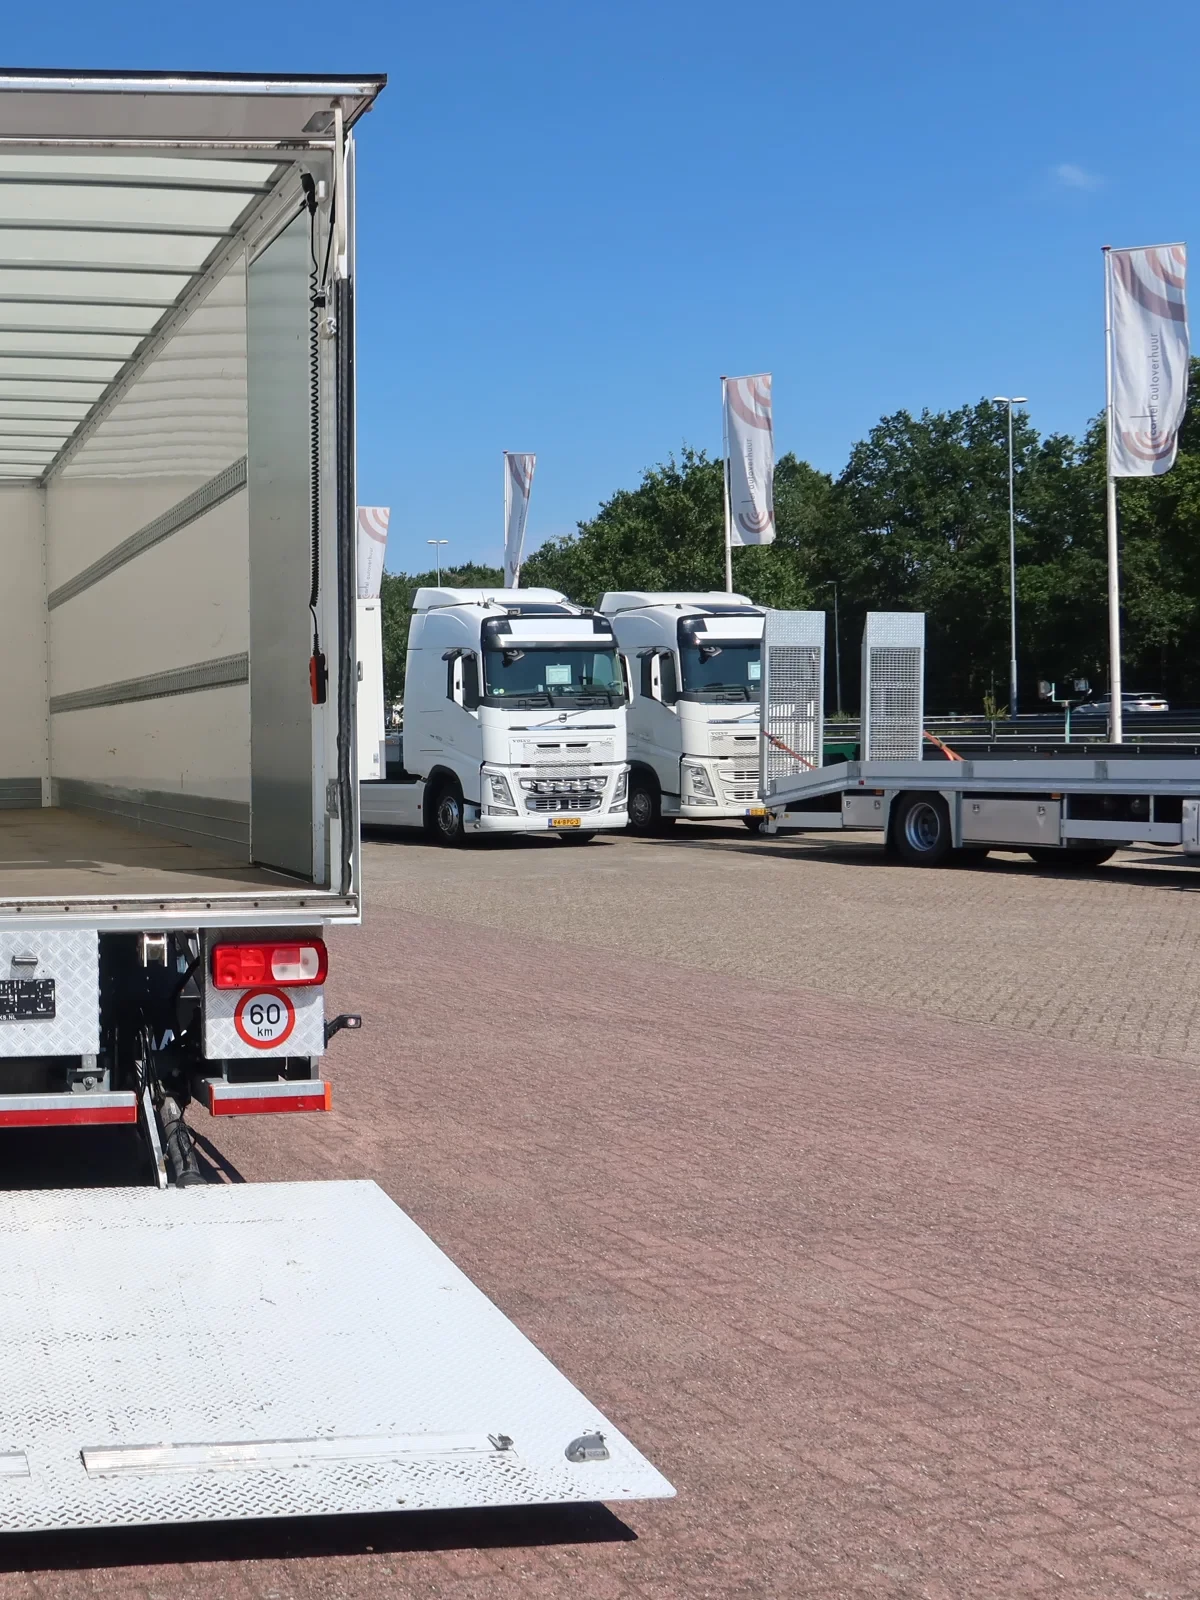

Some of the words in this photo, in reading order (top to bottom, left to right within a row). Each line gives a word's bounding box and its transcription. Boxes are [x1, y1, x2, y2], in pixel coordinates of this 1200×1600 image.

[1147, 333, 1160, 401] autoverhuur
[745, 438, 757, 490] autoverhuur
[249, 1003, 281, 1025] 60
[257, 1026, 273, 1037] km
